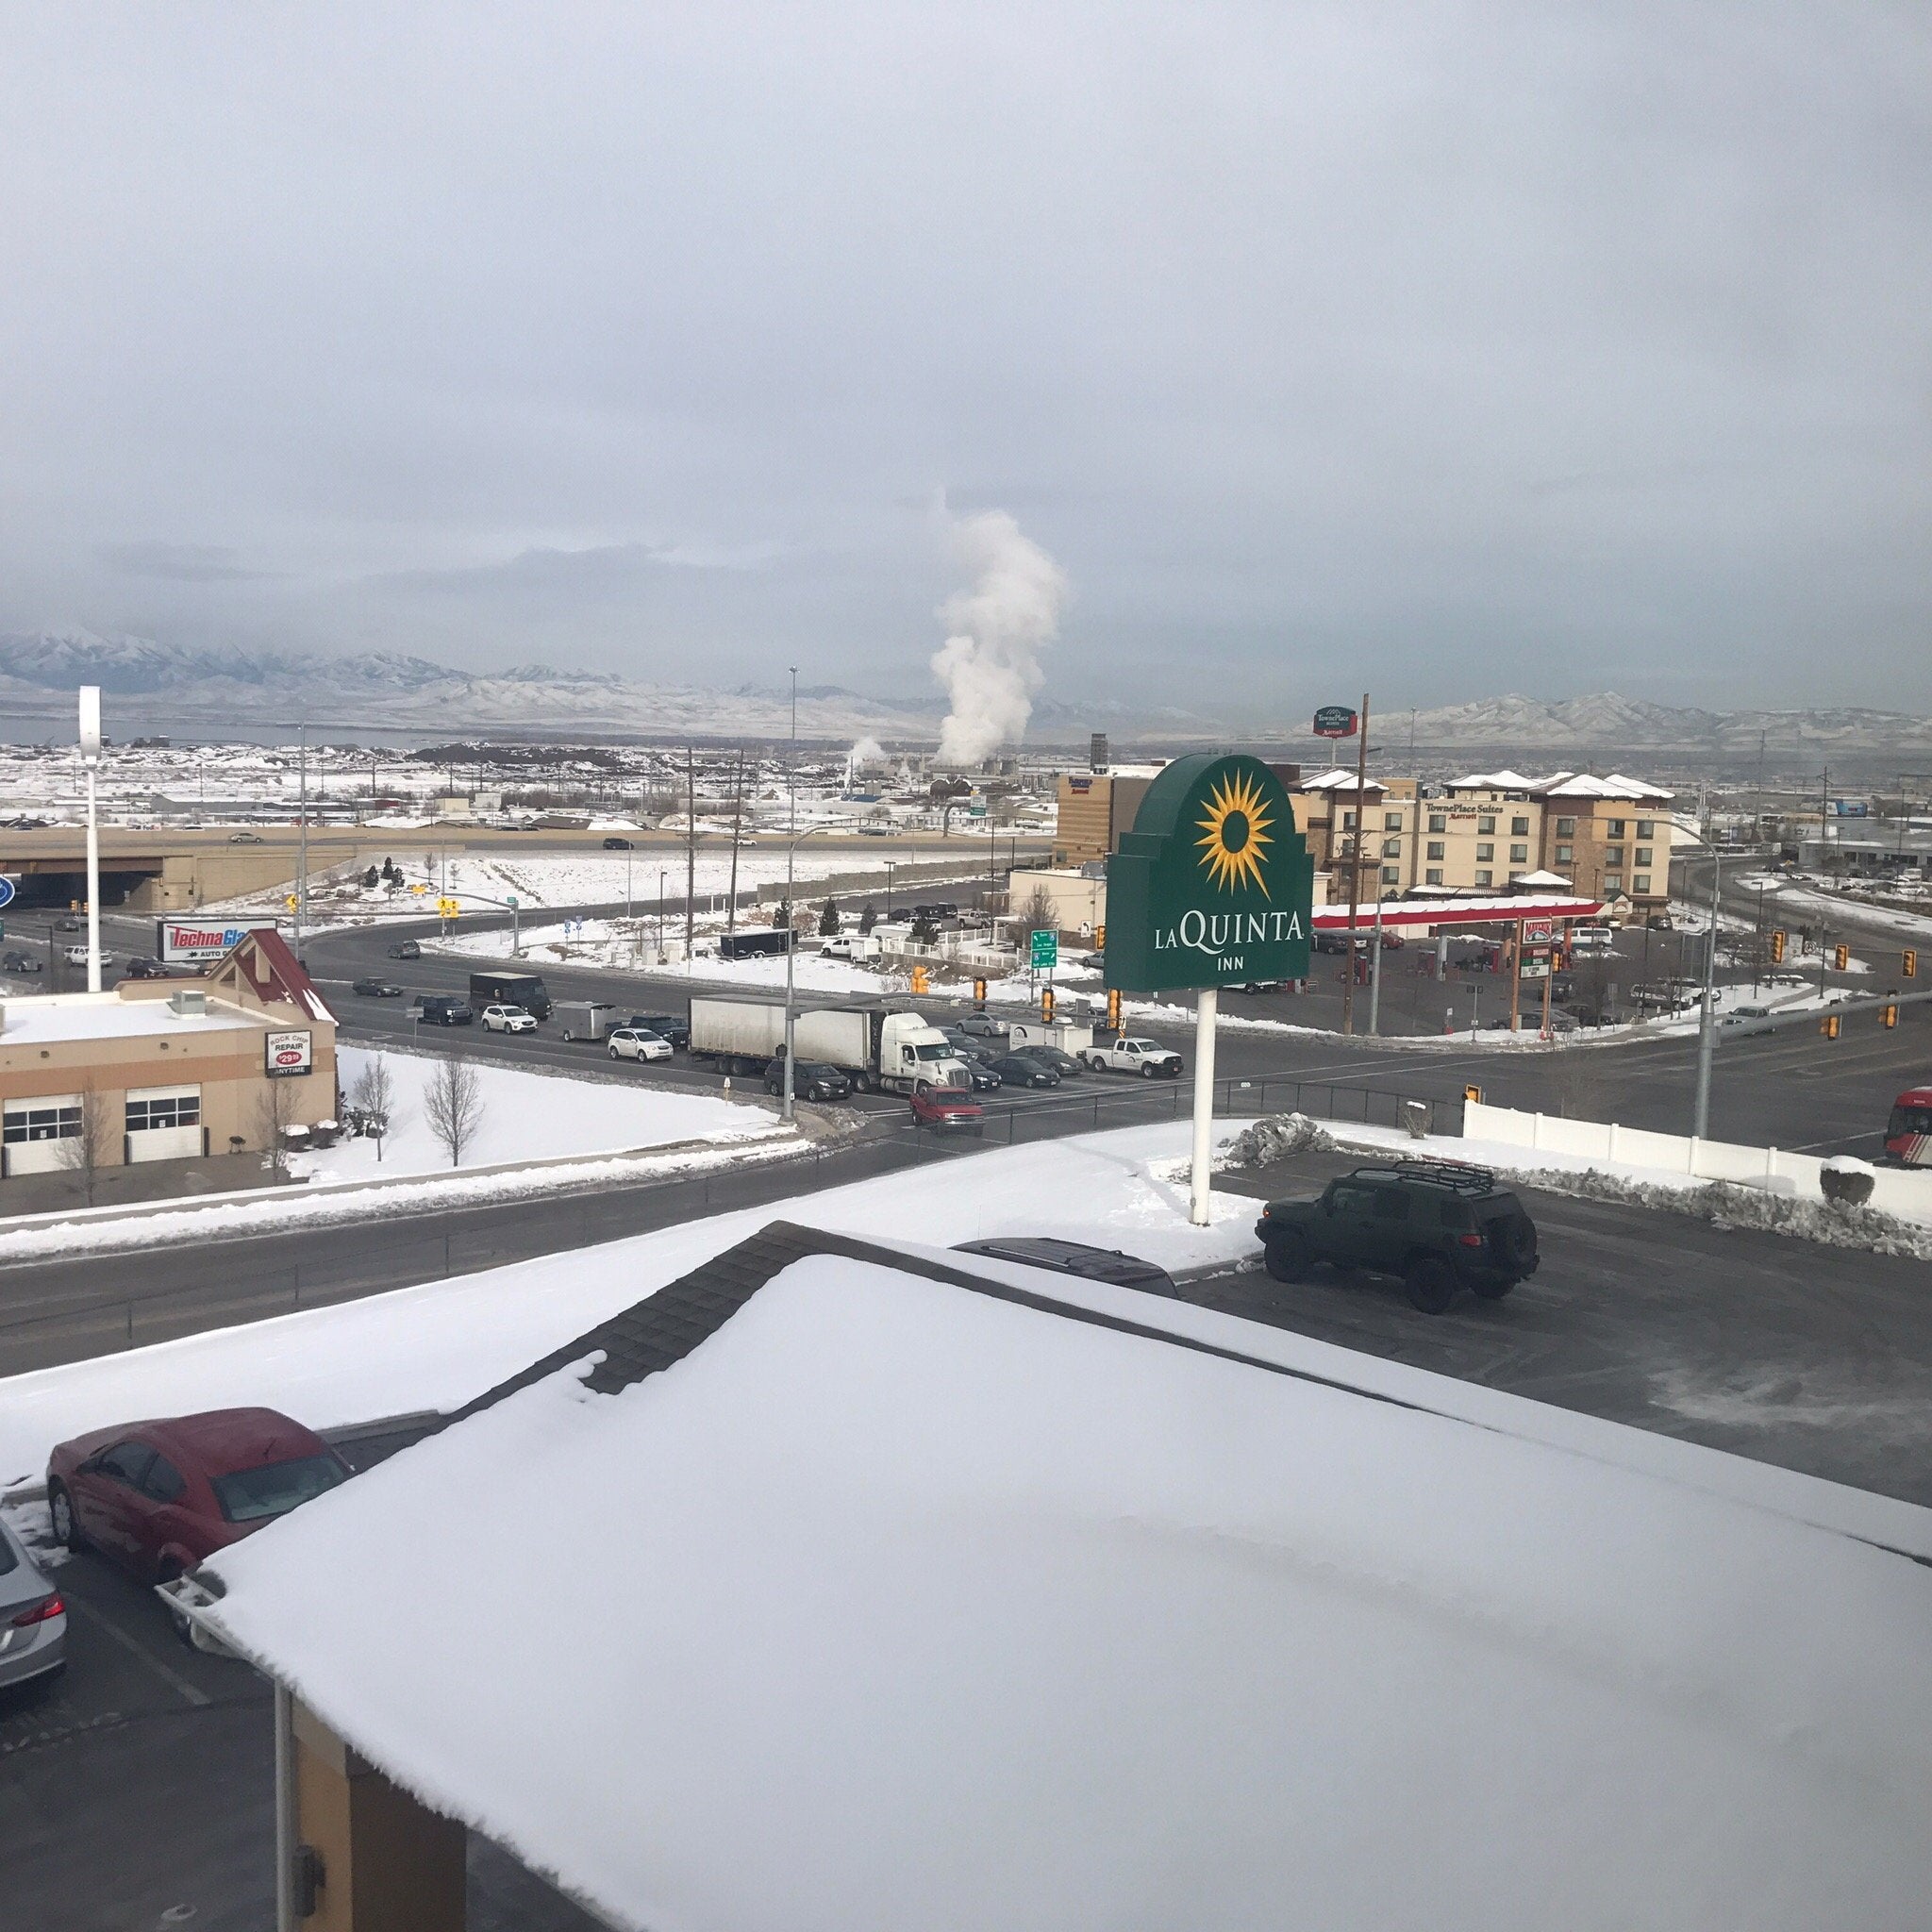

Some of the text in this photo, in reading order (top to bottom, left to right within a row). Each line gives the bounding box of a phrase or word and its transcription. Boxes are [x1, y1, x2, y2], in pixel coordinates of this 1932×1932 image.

[1425, 804, 1504, 814] TownePlace Suites
[166, 924, 246, 947] TechnaGla
[1154, 909, 1305, 955] LA QUINTA
[1217, 956, 1244, 972] INN
[270, 1034, 308, 1046] ROCK CHIP
[275, 1042, 304, 1051] REPAIR
[275, 1066, 306, 1074] ANYTIME
